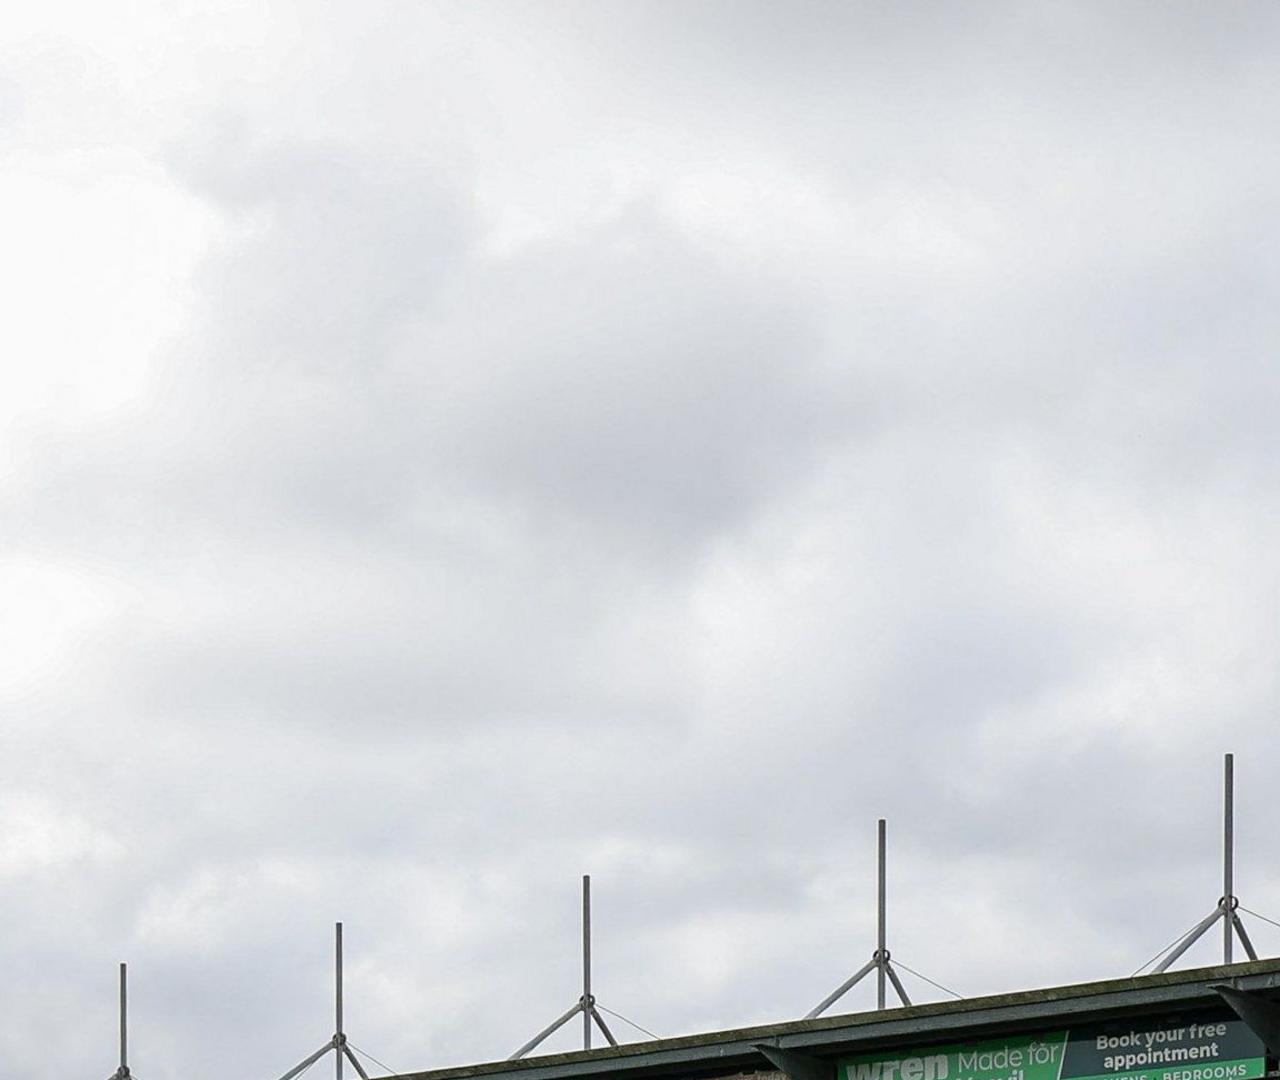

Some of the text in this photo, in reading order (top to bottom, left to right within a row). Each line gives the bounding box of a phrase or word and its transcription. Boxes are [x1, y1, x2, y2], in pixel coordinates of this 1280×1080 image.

[1096, 1023, 1227, 1051] Book your free
[957, 1041, 1060, 1073] Made for
[1103, 1042, 1219, 1071] appointment
